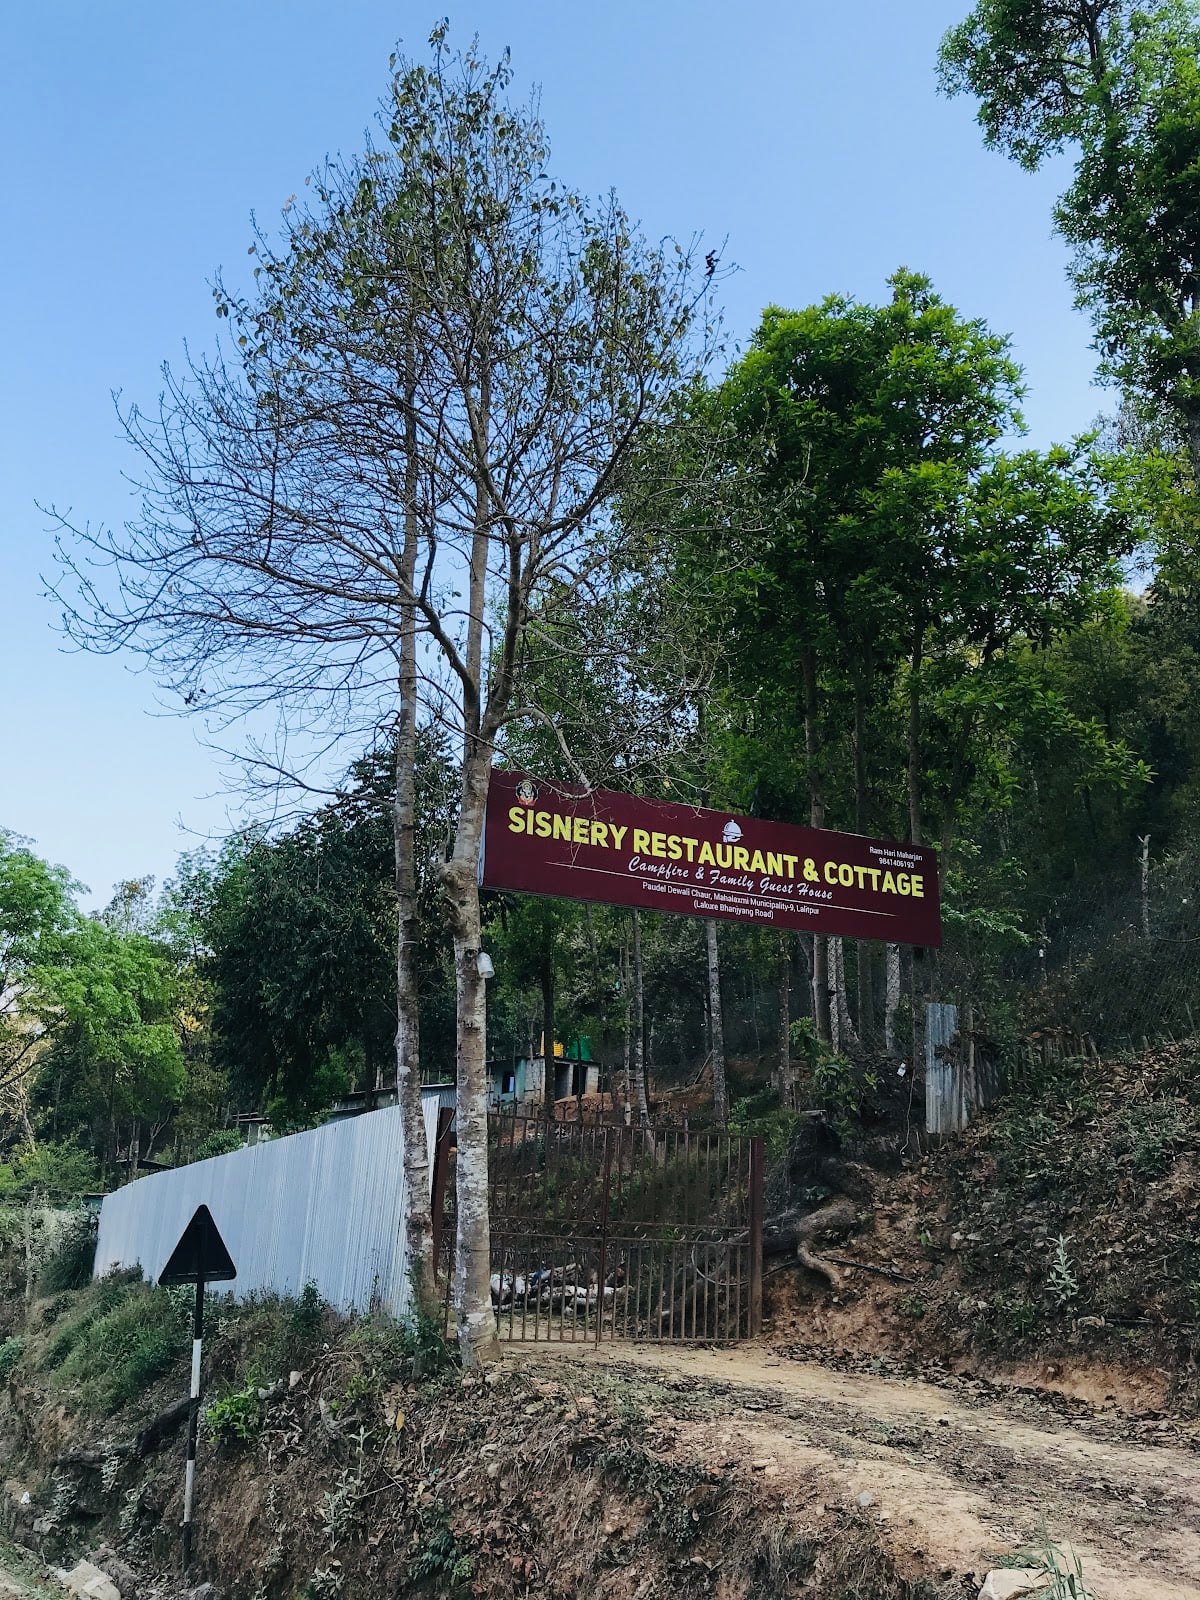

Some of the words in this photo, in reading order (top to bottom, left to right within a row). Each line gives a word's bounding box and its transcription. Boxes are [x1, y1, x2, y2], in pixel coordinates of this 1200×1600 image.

[508, 806, 628, 850] SISNERY
[633, 828, 798, 879] RESTAURANT
[802, 857, 820, 883] &
[824, 861, 925, 898] COTTAGE
[869, 846, 883, 855] Ram
[883, 848, 896, 857] Hari
[628, 855, 689, 879] Campfire
[695, 866, 704, 879] &
[709, 869, 754, 891] Family
[760, 876, 793, 894] Guest
[797, 882, 833, 900] House
[642, 881, 667, 893] Paudel
[667, 885, 690, 896] Dewali
[691, 889, 713, 900] Chaur,
[713, 892, 749, 905] Mahalaxmi
[750, 897, 796, 912] Municipality-9,
[796, 904, 820, 915] Lalitpur
[693, 899, 719, 911] (Lakure
[719, 903, 754, 917] Bhanjyang
[754, 909, 774, 920] Road)
